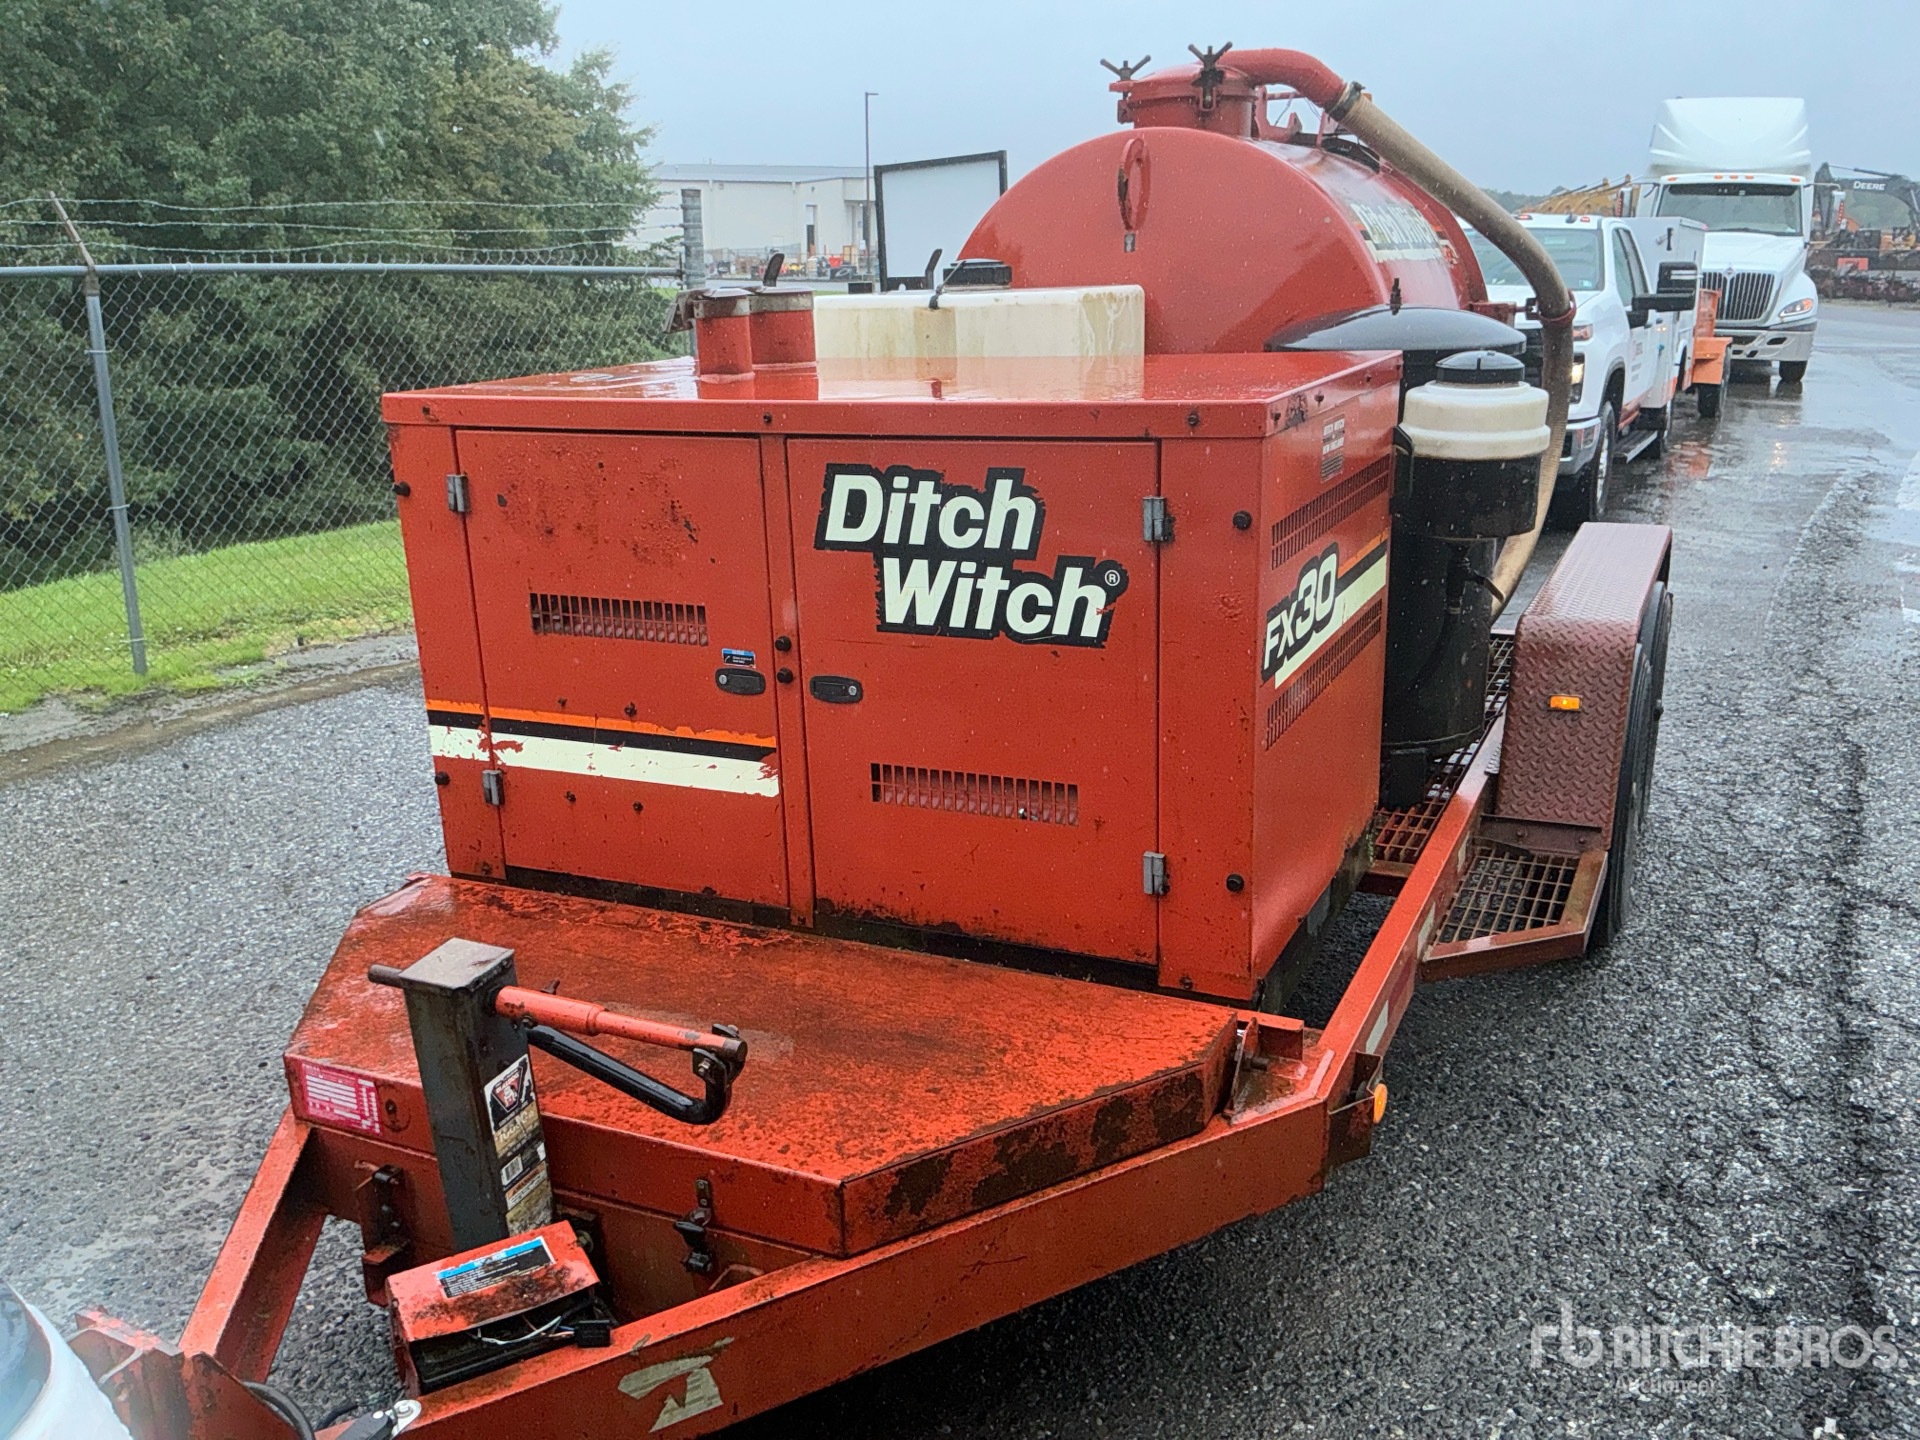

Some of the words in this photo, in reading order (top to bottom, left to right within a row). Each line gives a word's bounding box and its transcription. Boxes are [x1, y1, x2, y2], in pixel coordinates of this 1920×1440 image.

[1853, 180, 1886, 191] DEERE
[824, 474, 1038, 552] Ditch
[1263, 552, 1337, 670] FX30
